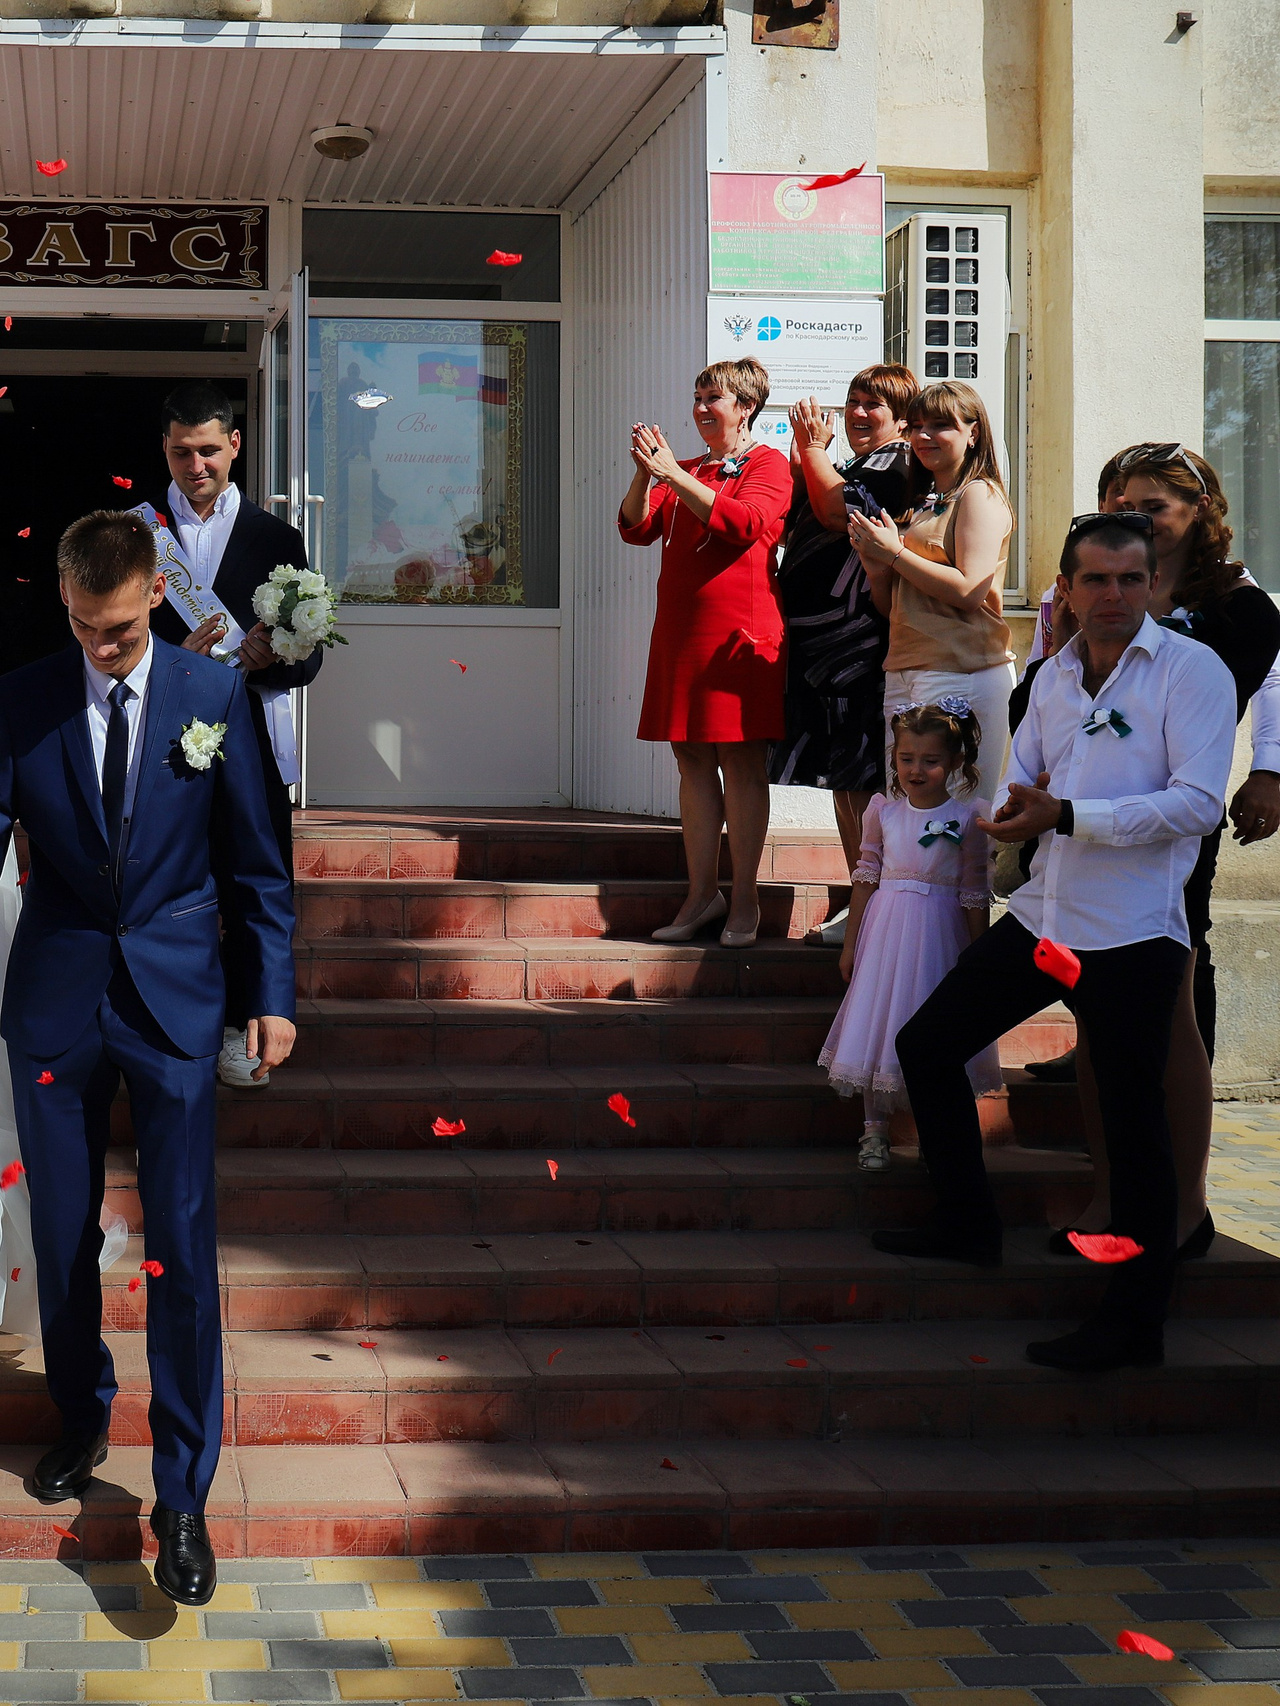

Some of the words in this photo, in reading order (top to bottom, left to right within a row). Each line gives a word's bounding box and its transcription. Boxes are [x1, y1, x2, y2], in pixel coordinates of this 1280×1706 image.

[786, 320, 863, 334] Роскадастр
[795, 334, 850, 342] Краснодарскому
[397, 412, 438, 433] Все
[385, 452, 471, 464] начинается
[427, 485, 433, 494] с
